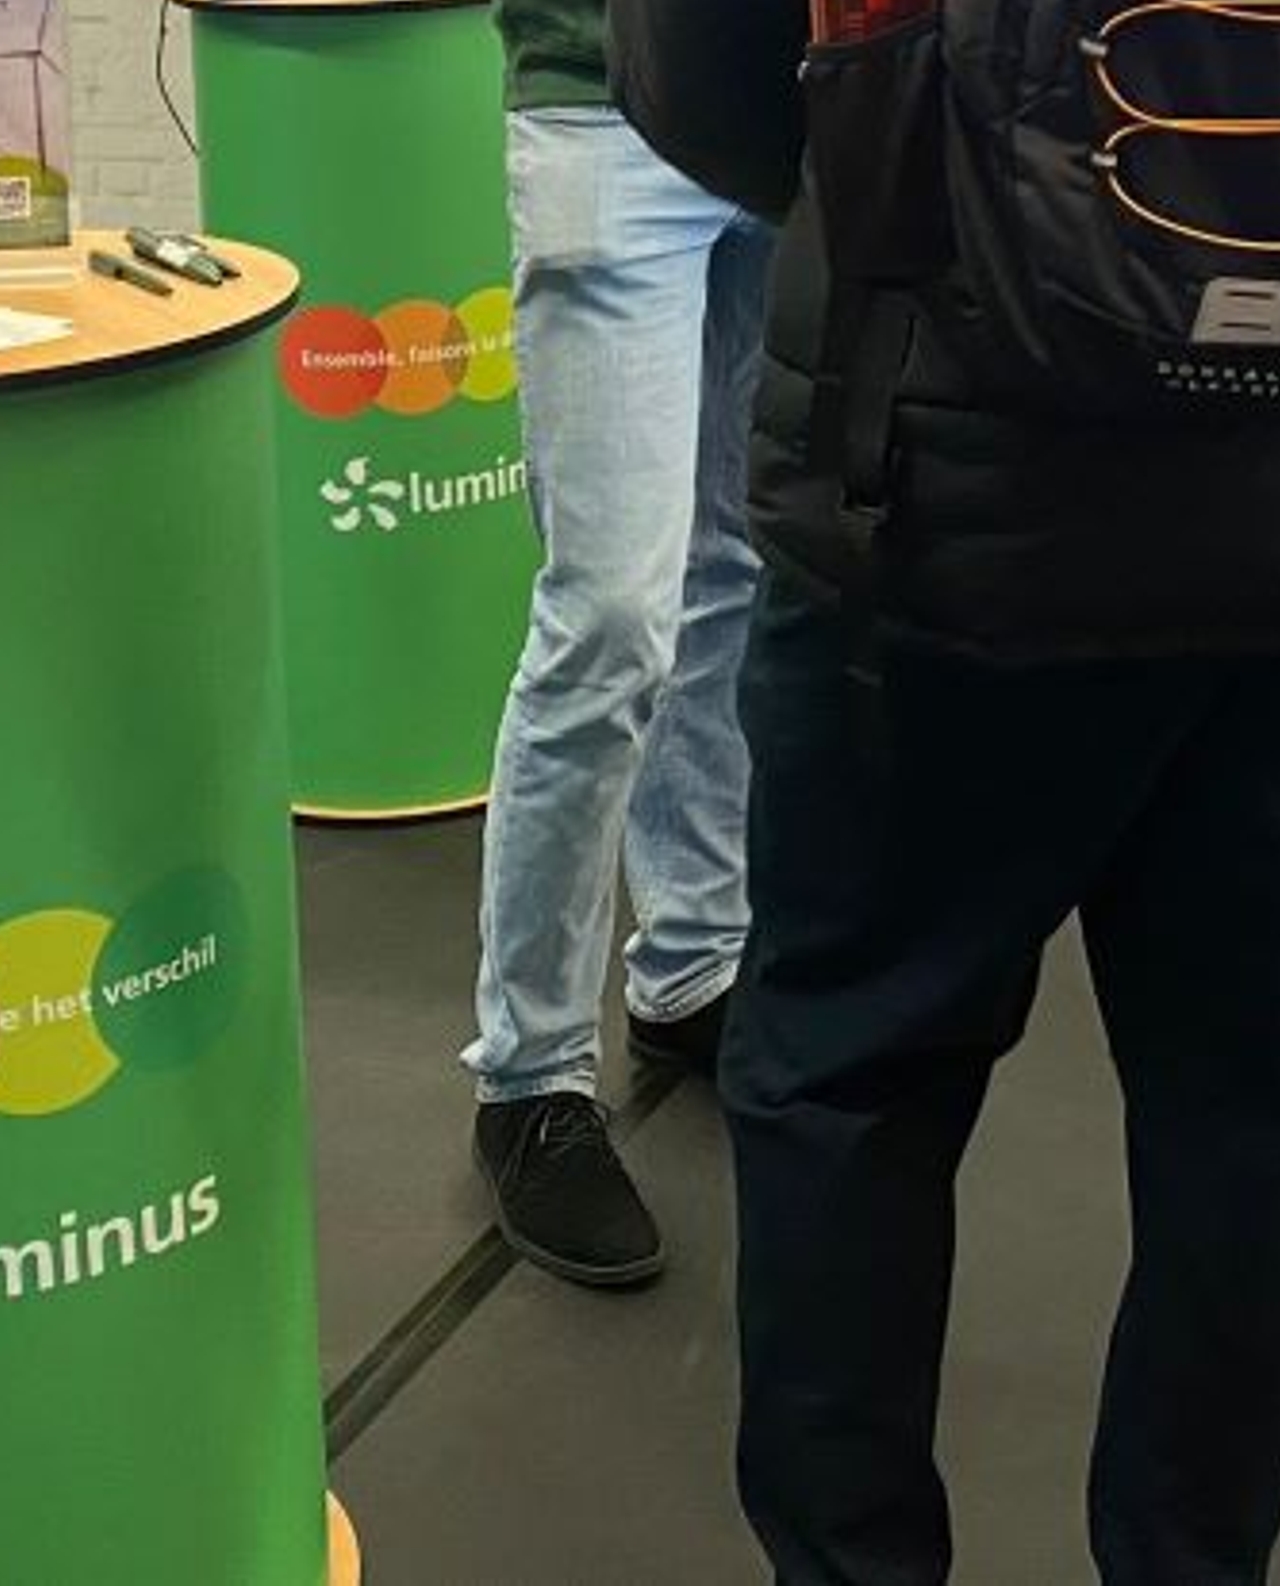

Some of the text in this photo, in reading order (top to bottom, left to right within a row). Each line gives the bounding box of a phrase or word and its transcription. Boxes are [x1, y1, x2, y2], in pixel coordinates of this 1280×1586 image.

[301, 349, 404, 370] Ensemble,
[31, 990, 92, 1028] het
[102, 934, 217, 1008] verschil
